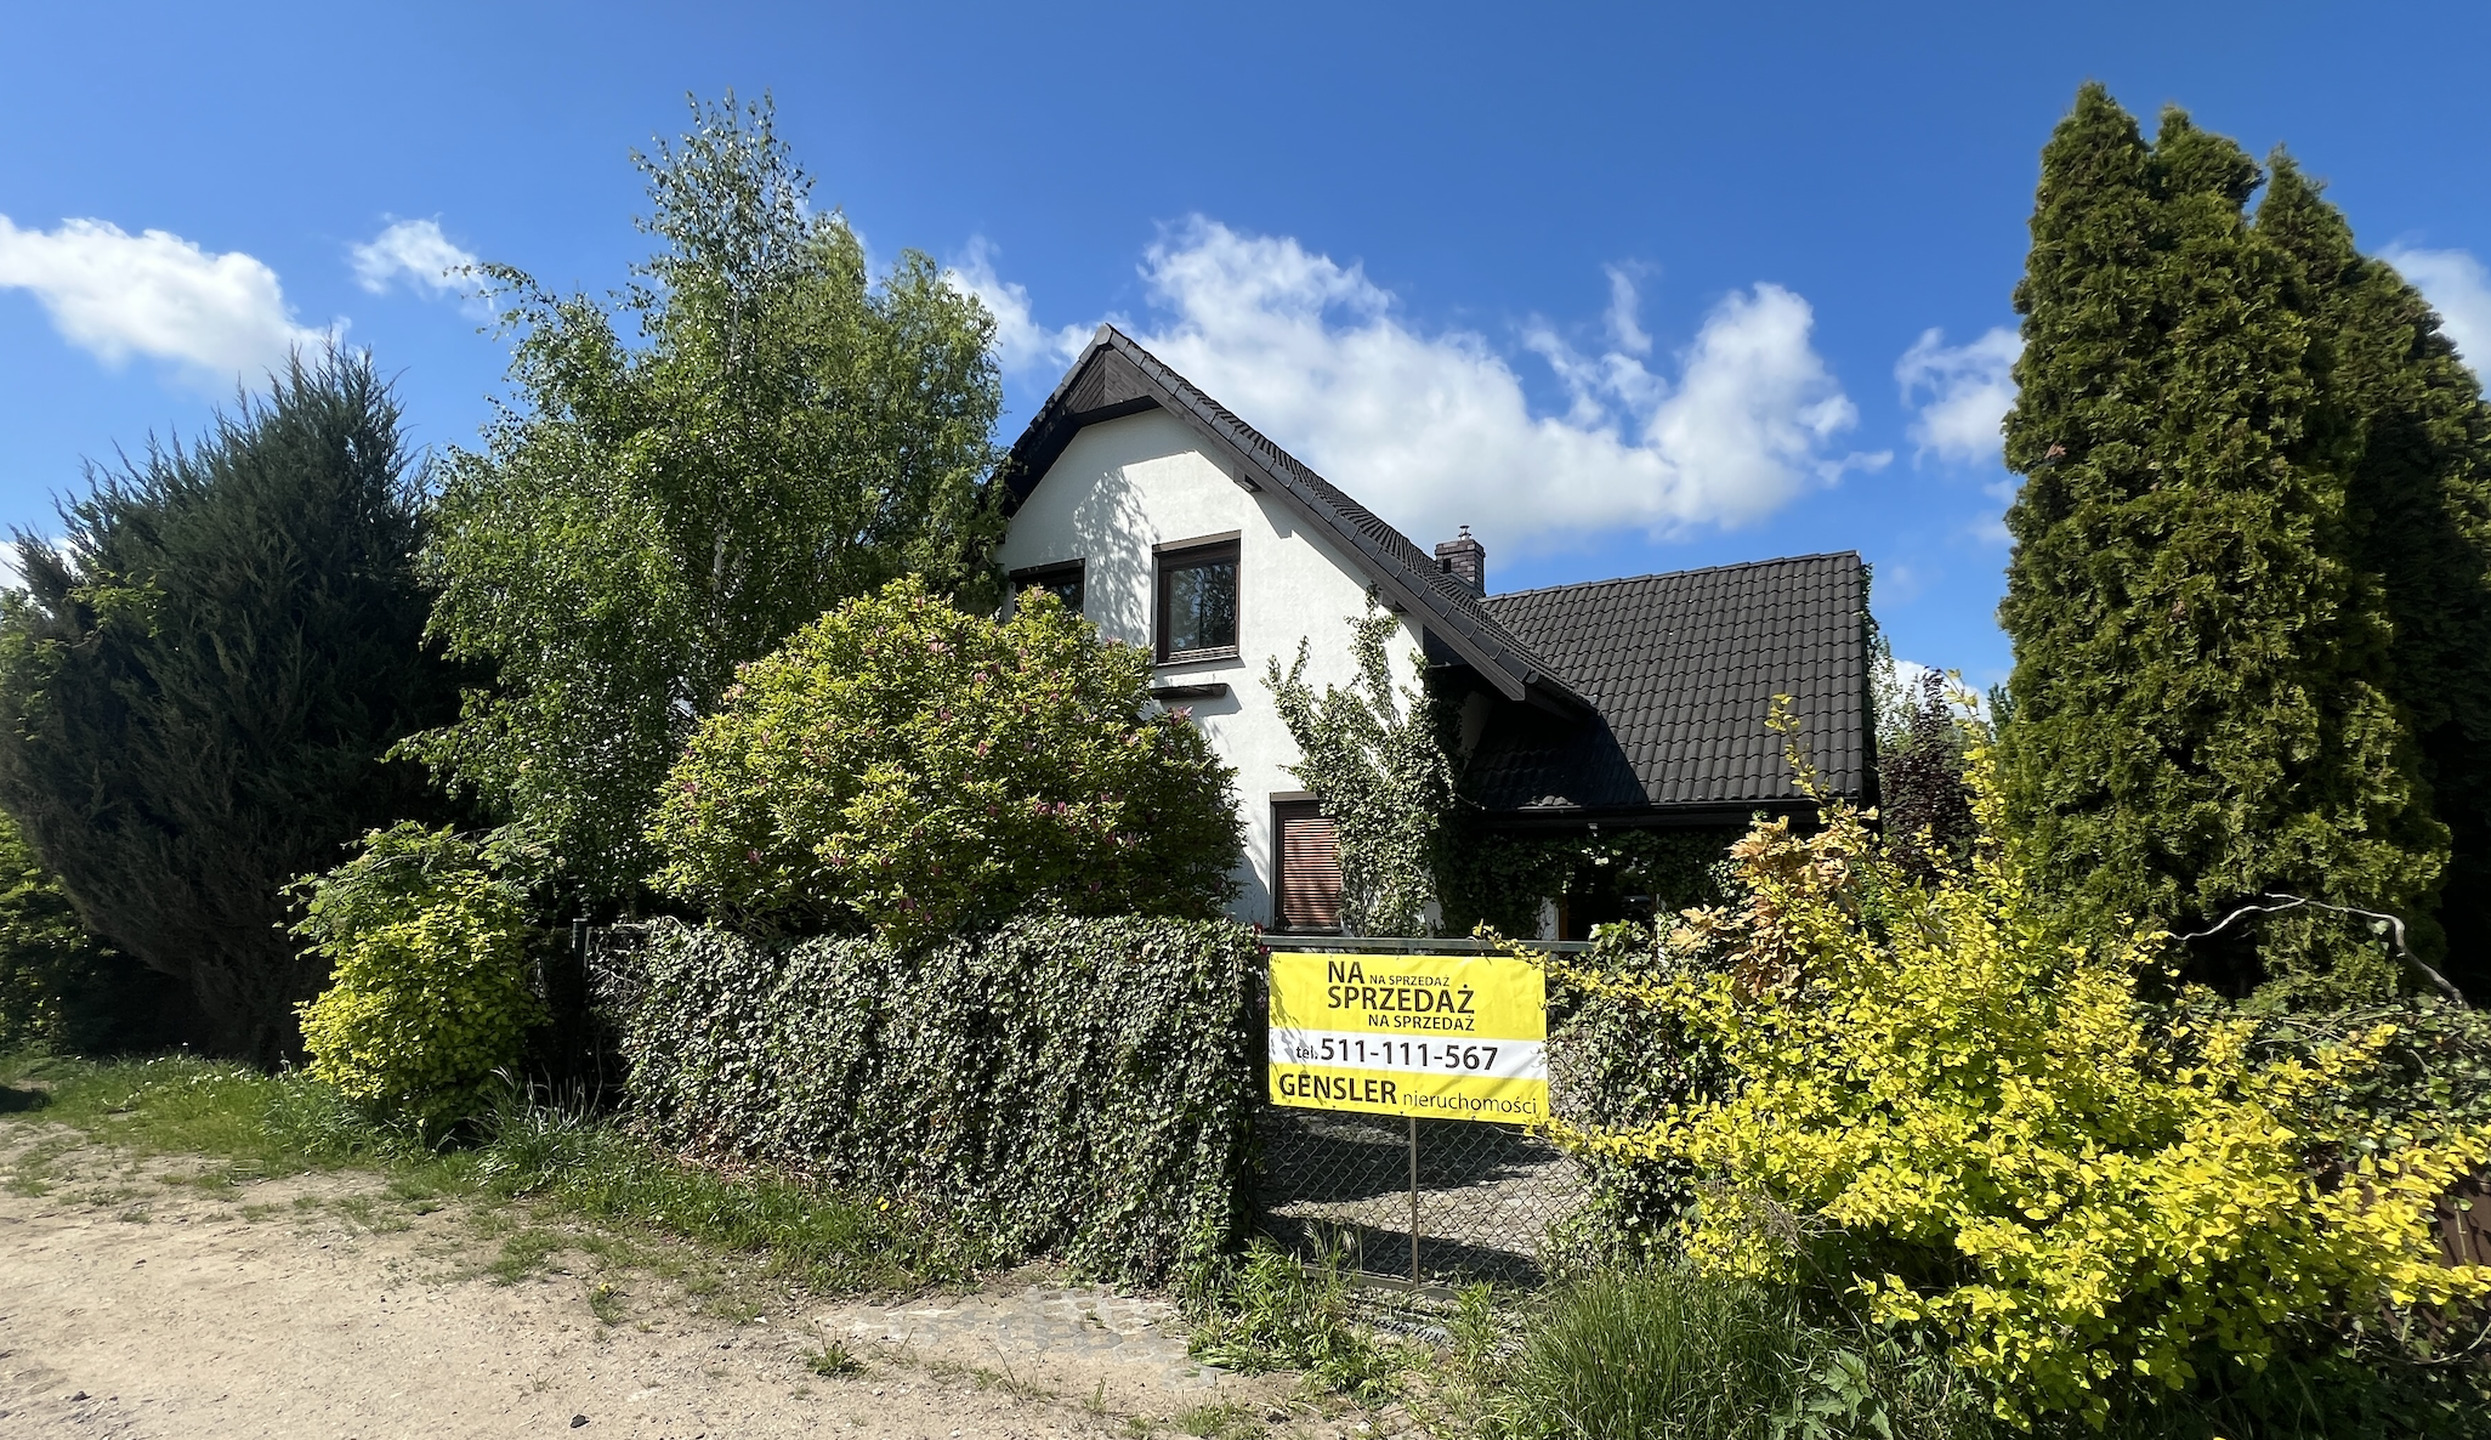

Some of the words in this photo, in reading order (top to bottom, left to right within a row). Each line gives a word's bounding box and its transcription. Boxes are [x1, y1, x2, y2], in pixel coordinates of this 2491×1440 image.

[1328, 960, 1365, 984] NA
[1369, 974, 1385, 985] NA
[1389, 974, 1450, 987] SPRZEDAŻ
[1327, 983, 1475, 1015] SPRZEDAŻ
[1368, 1014, 1389, 1028] NA
[1393, 1015, 1475, 1032] SPRZEDAŻ
[1278, 1073, 1397, 1105] GENSLER
[1403, 1090, 1537, 1115] nieruchomości
